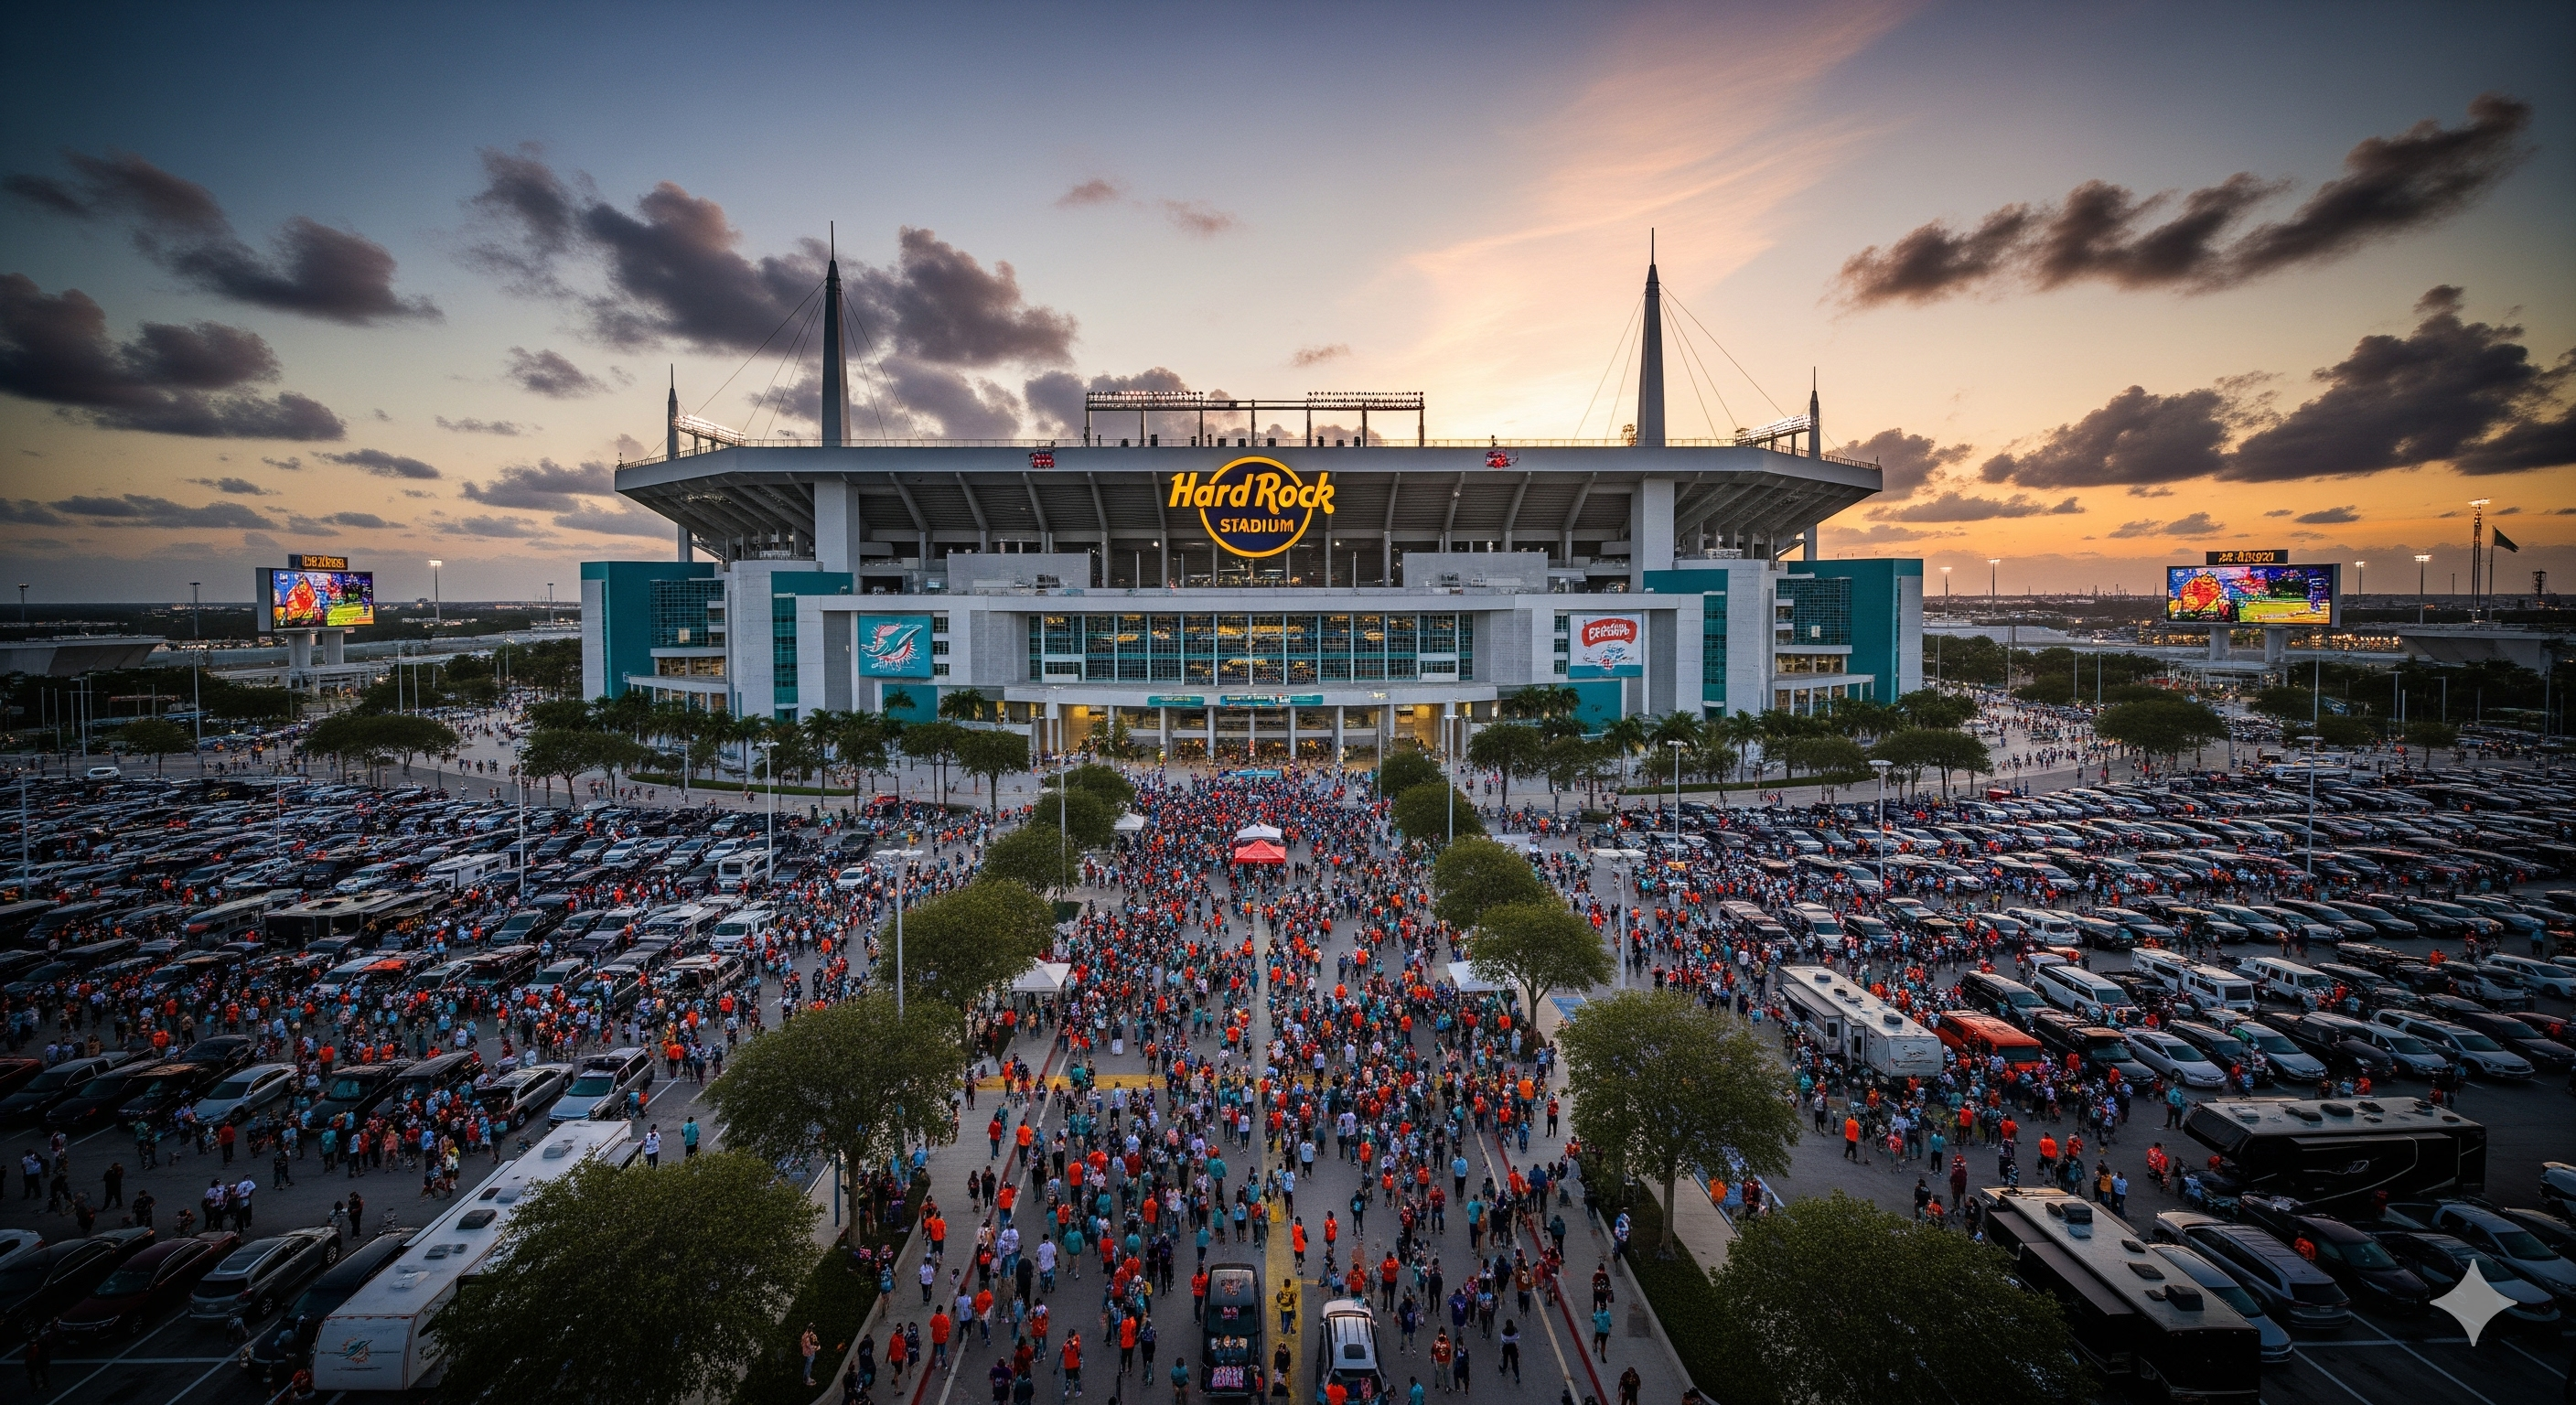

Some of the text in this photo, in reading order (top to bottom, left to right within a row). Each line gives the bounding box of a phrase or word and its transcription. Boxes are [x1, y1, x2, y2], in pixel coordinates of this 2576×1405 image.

[1168, 472, 1336, 515] Hard Rock
[1219, 518, 1294, 533] STADIUM
